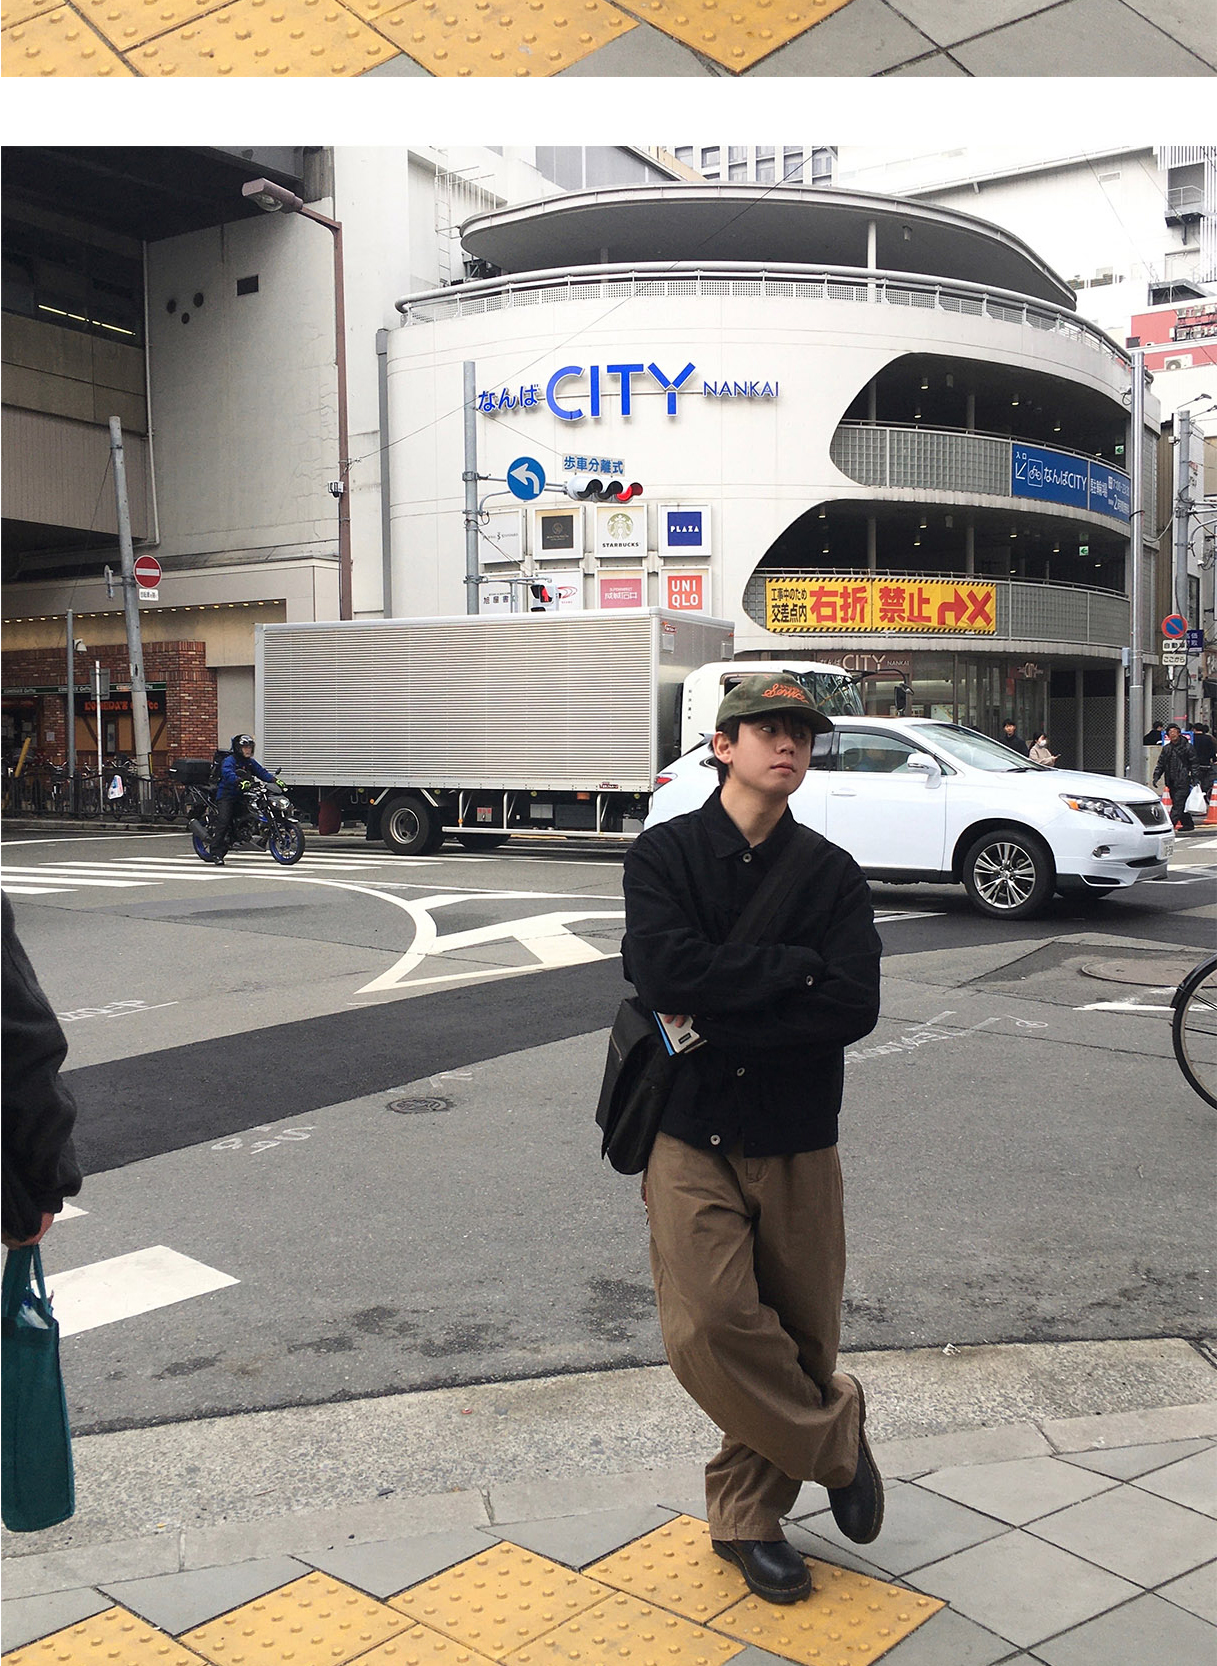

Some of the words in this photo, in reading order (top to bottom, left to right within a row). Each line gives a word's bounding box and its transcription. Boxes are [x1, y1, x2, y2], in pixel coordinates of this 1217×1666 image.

[477, 383, 541, 413] なんば
[545, 362, 696, 421] CITY
[702, 381, 779, 398] NANKAI
[563, 455, 624, 475] 歩車分離式
[1043, 466, 1088, 491] なんばCITY
[670, 525, 700, 533] PLAZA
[671, 579, 696, 592] UNI
[771, 587, 807, 602] 工事中のため
[671, 594, 699, 609] QLO
[809, 585, 868, 624] 右折
[878, 586, 932, 624] 禁止
[771, 603, 807, 623] 交差点内
[842, 654, 886, 671] CITY
